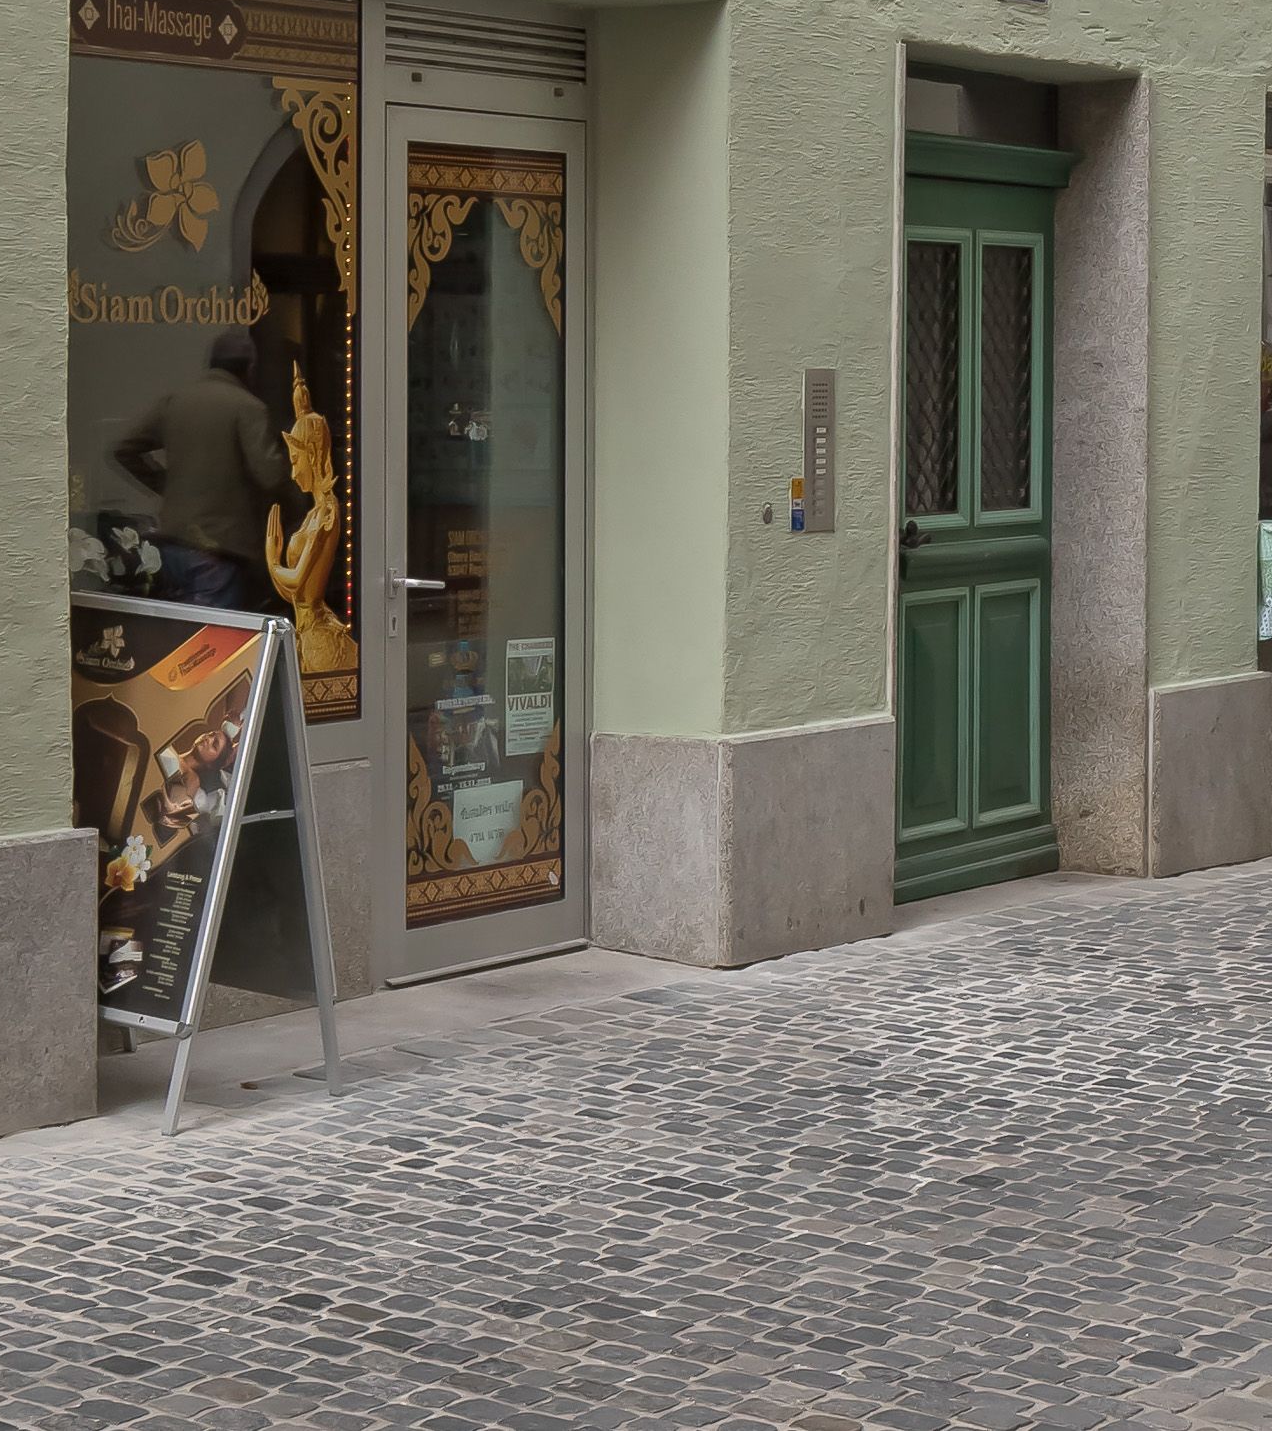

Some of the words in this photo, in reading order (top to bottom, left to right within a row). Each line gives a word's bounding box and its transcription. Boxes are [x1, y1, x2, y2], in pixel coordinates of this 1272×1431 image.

[74, 283, 154, 324] Siam
[160, 284, 253, 326] Orchid
[507, 695, 551, 712] VIVALDI
